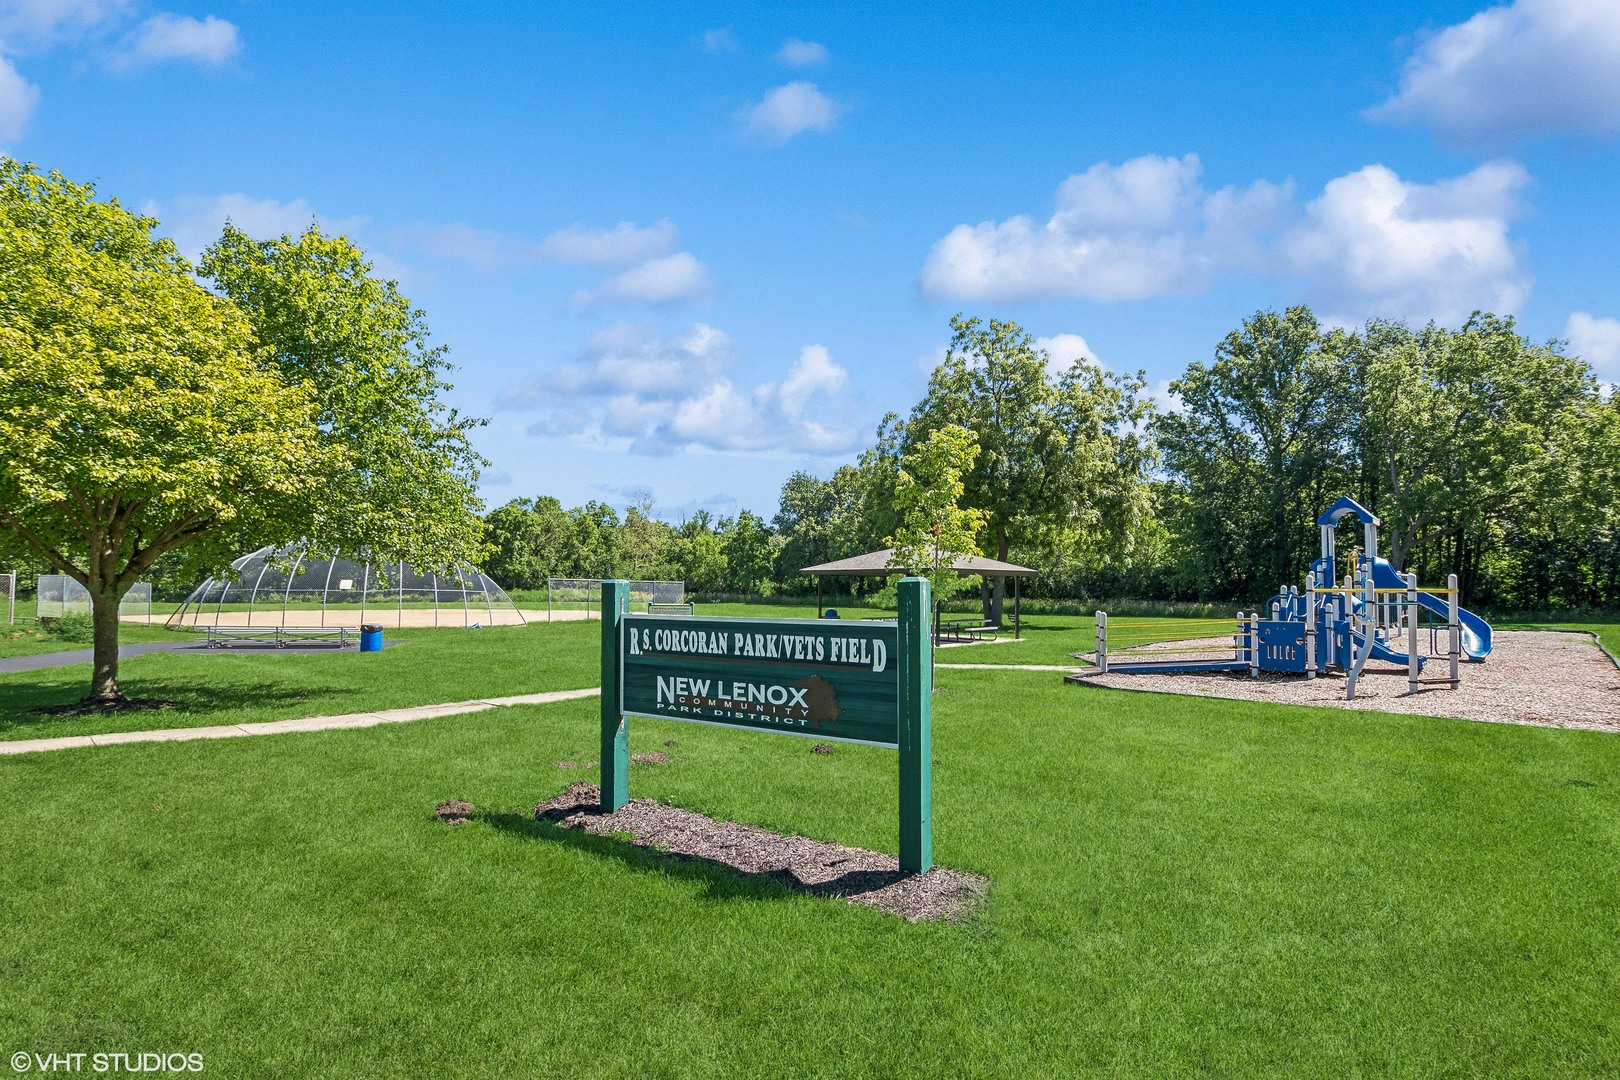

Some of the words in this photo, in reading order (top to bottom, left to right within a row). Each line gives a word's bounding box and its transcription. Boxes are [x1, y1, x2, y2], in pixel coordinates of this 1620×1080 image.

[654, 629, 728, 653] CORCORAN
[734, 633, 824, 661] PARK/VETS
[830, 637, 887, 672] FIELD
[656, 675, 711, 704] NEW
[718, 680, 809, 708] LENOX
[656, 703, 702, 713] PARK
[714, 709, 808, 726] DISTRICT
[678, 696, 809, 717] COMMUNITY
